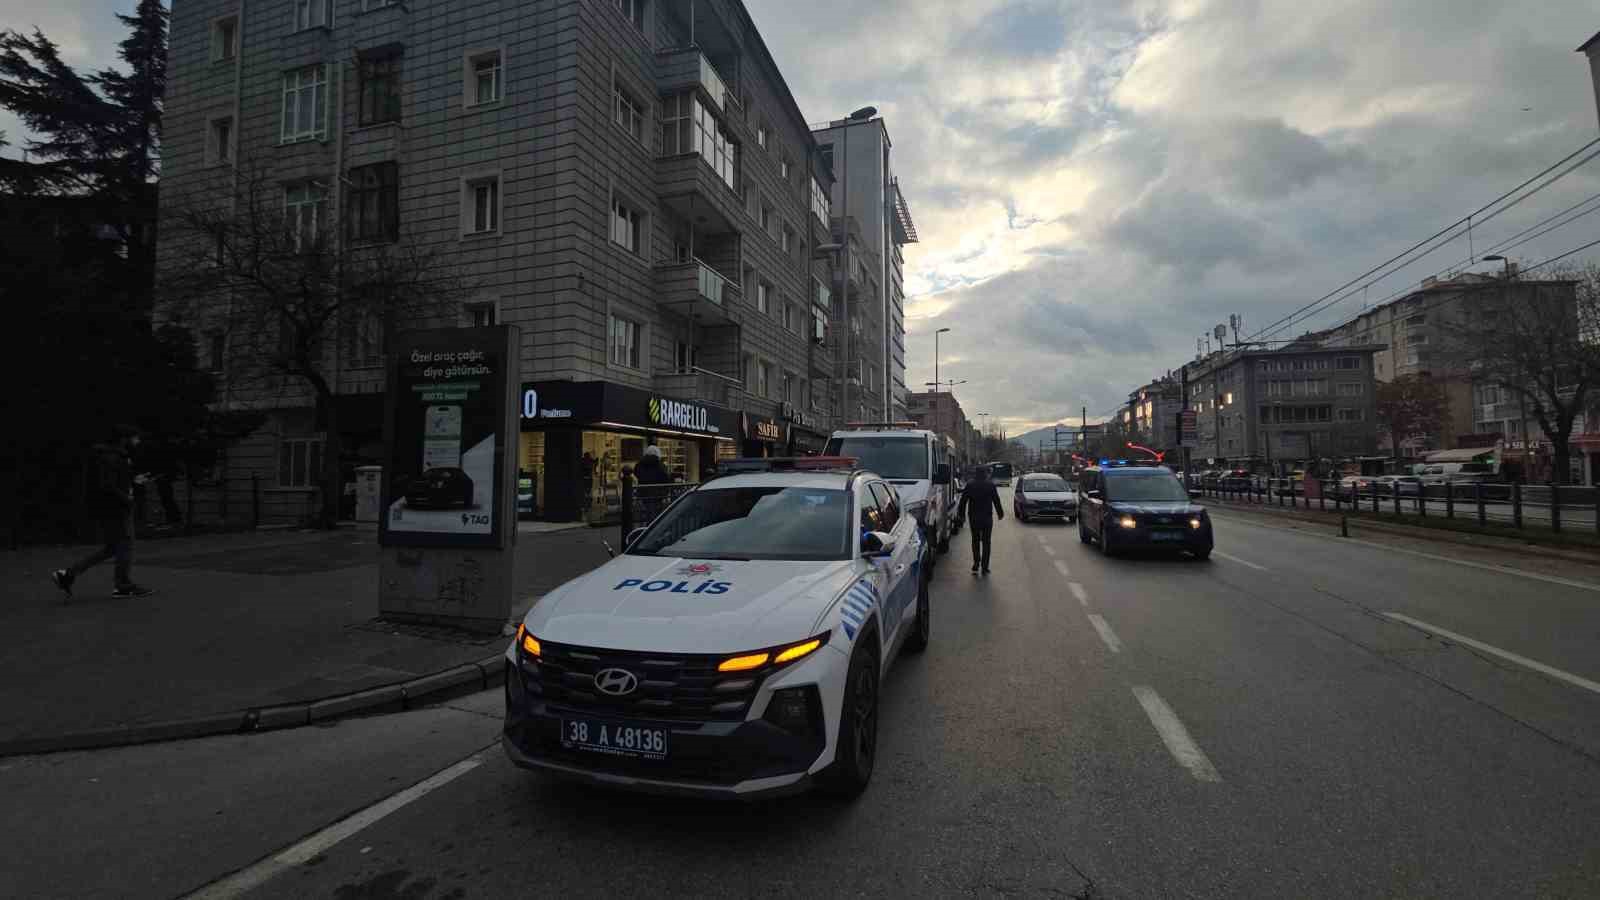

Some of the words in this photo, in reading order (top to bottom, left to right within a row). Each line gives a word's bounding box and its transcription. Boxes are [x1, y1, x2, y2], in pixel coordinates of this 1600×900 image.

[424, 367, 443, 379] diye
[660, 399, 708, 431] BARGELLO
[613, 579, 732, 594] POLİS
[569, 720, 588, 742] 38
[599, 725, 609, 746] A
[615, 727, 663, 751] 48136
